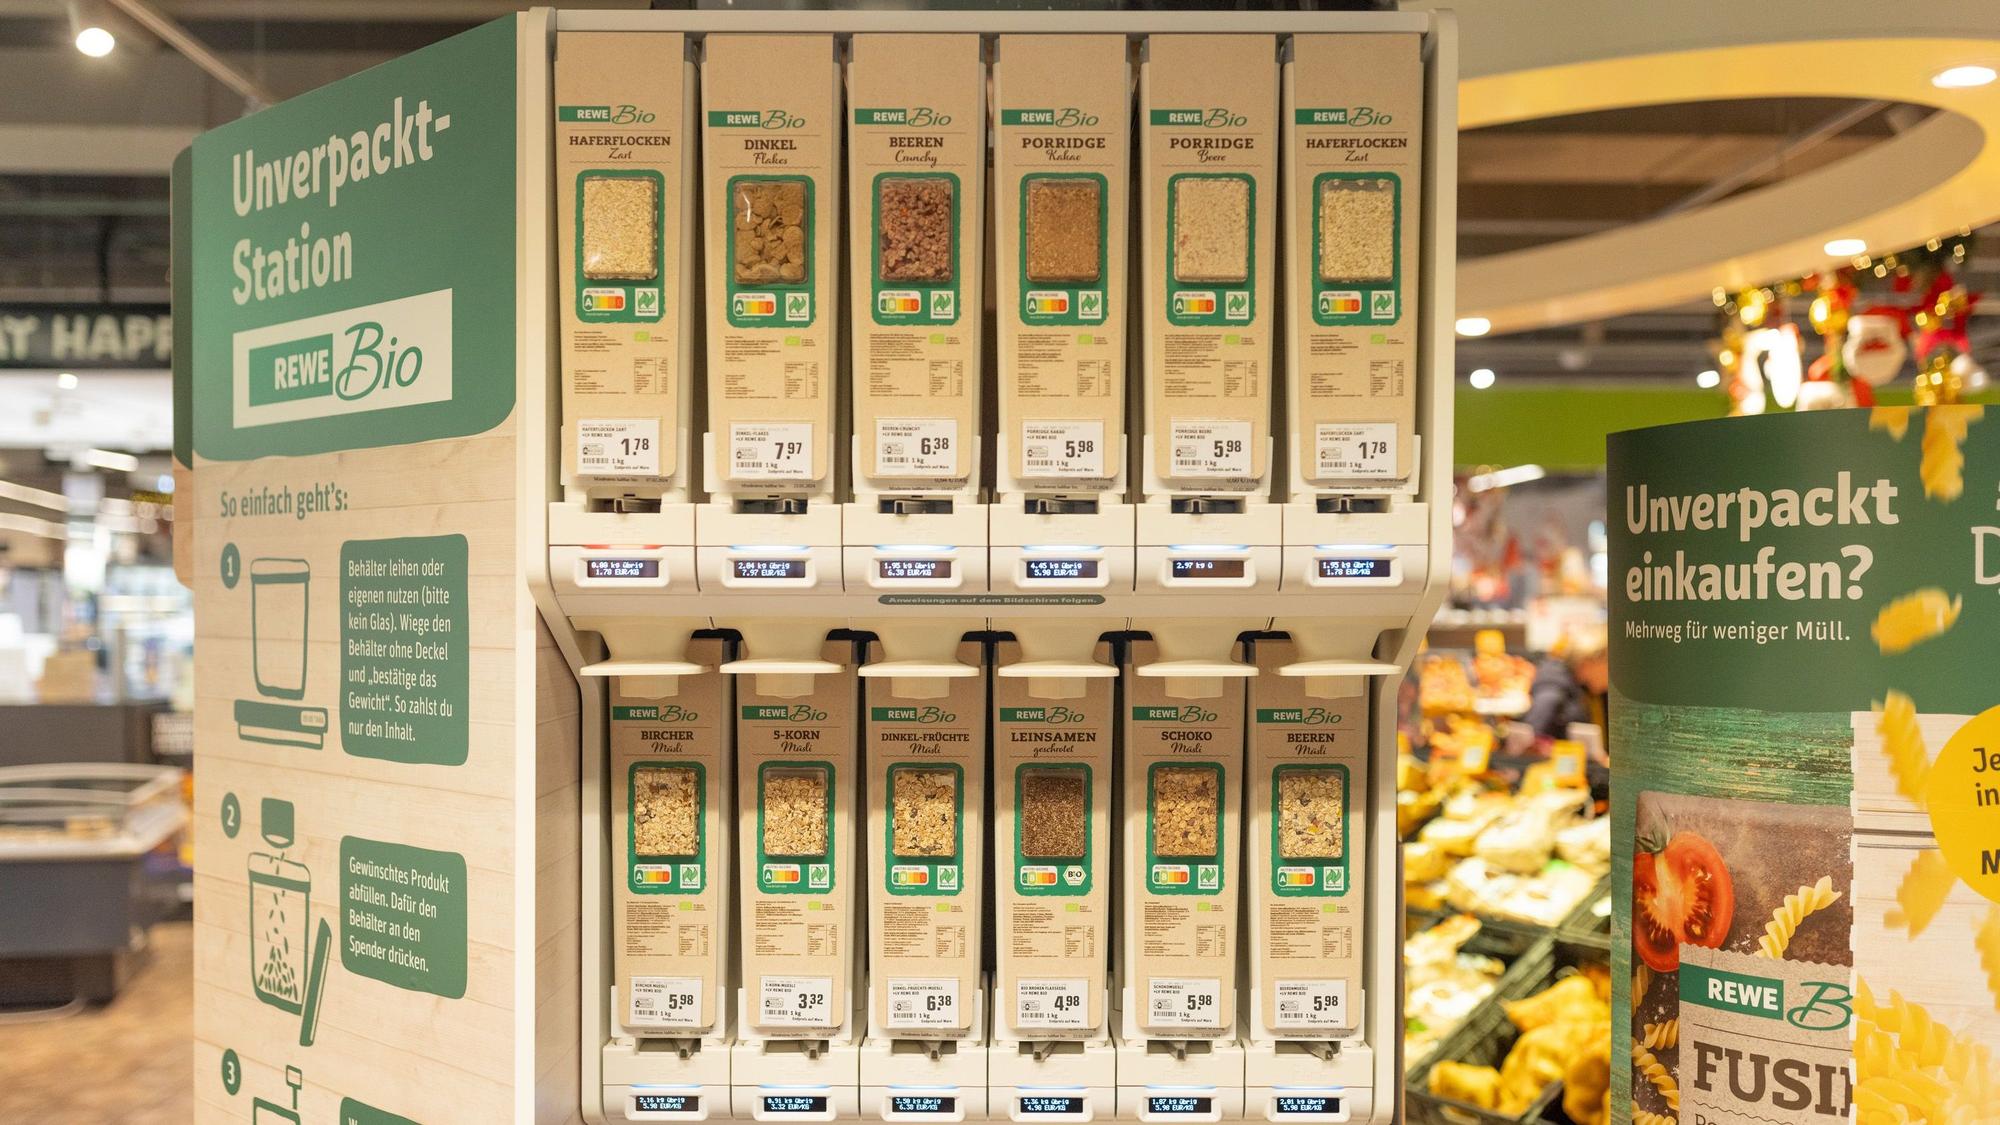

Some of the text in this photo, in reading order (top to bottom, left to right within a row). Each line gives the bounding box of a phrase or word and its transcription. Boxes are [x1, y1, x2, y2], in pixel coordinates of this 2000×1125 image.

[577, 105, 655, 125] REWE Bio
[727, 110, 805, 129] REWE Bio
[873, 107, 952, 128] REWE Bio
[1021, 108, 1099, 128] REWE Bio
[1169, 108, 1248, 128] REWE Bio
[1313, 107, 1393, 127] REWE Bio
[569, 136, 671, 146] HAFERFLOCKEN
[744, 139, 797, 150] DINKEL
[889, 137, 944, 148] BEEREN
[1022, 137, 1106, 149] PORRIDGE
[1169, 138, 1254, 149] PORRIDGE
[1306, 138, 1408, 149] HAFERFLOCKEN
[233, 96, 451, 217] Unverpackt-
[232, 221, 352, 306] Station
[274, 321, 423, 401] REWE Bio
[220, 491, 237, 517] So
[241, 485, 292, 517] einfach
[1626, 471, 1900, 542] Unverpackt
[226, 555, 235, 577] 1
[349, 558, 445, 577] Behälter leihen oder
[1626, 544, 1874, 602] einkaufen?
[348, 585, 450, 607] eigenen nutzen (bitte
[888, 597, 958, 605] Anweisungen
[1061, 597, 1098, 605] folgen.
[348, 612, 451, 636] kein Glas). Wiege den
[1625, 619, 1850, 645] Mehrweg für weniger Müll.
[349, 639, 449, 661] Behälter ohne Deckel
[348, 667, 366, 683] und
[419, 670, 437, 688] das
[395, 695, 407, 713] So
[409, 697, 438, 717] zahlst
[439, 701, 453, 717] du
[629, 705, 698, 723] REWE Bio
[759, 704, 828, 723] REWE Bio
[888, 706, 956, 724] REWE Bio
[1016, 706, 1085, 724] REWE Bio
[1149, 706, 1218, 723] REWE Bio
[1273, 708, 1342, 725] REWE Bio
[348, 720, 416, 742] nur den Inhalt.
[641, 731, 694, 740] BIRCHER
[773, 730, 820, 740] 5-KORN
[881, 731, 970, 742] DINKEL-FRÜCHTE
[1011, 732, 1097, 742] LEINSAMEN
[1161, 731, 1213, 741] SCHOKO
[1287, 733, 1335, 743] BEEREN
[226, 808, 236, 827] 2
[349, 856, 450, 894] Gewünschtes Produkt
[349, 884, 437, 918] abfüllen. Dafür den
[349, 909, 421, 942] Behälter an den
[349, 935, 429, 972] Spender drücken.
[1708, 977, 1778, 1011] REWE
[226, 1061, 236, 1085] 3
